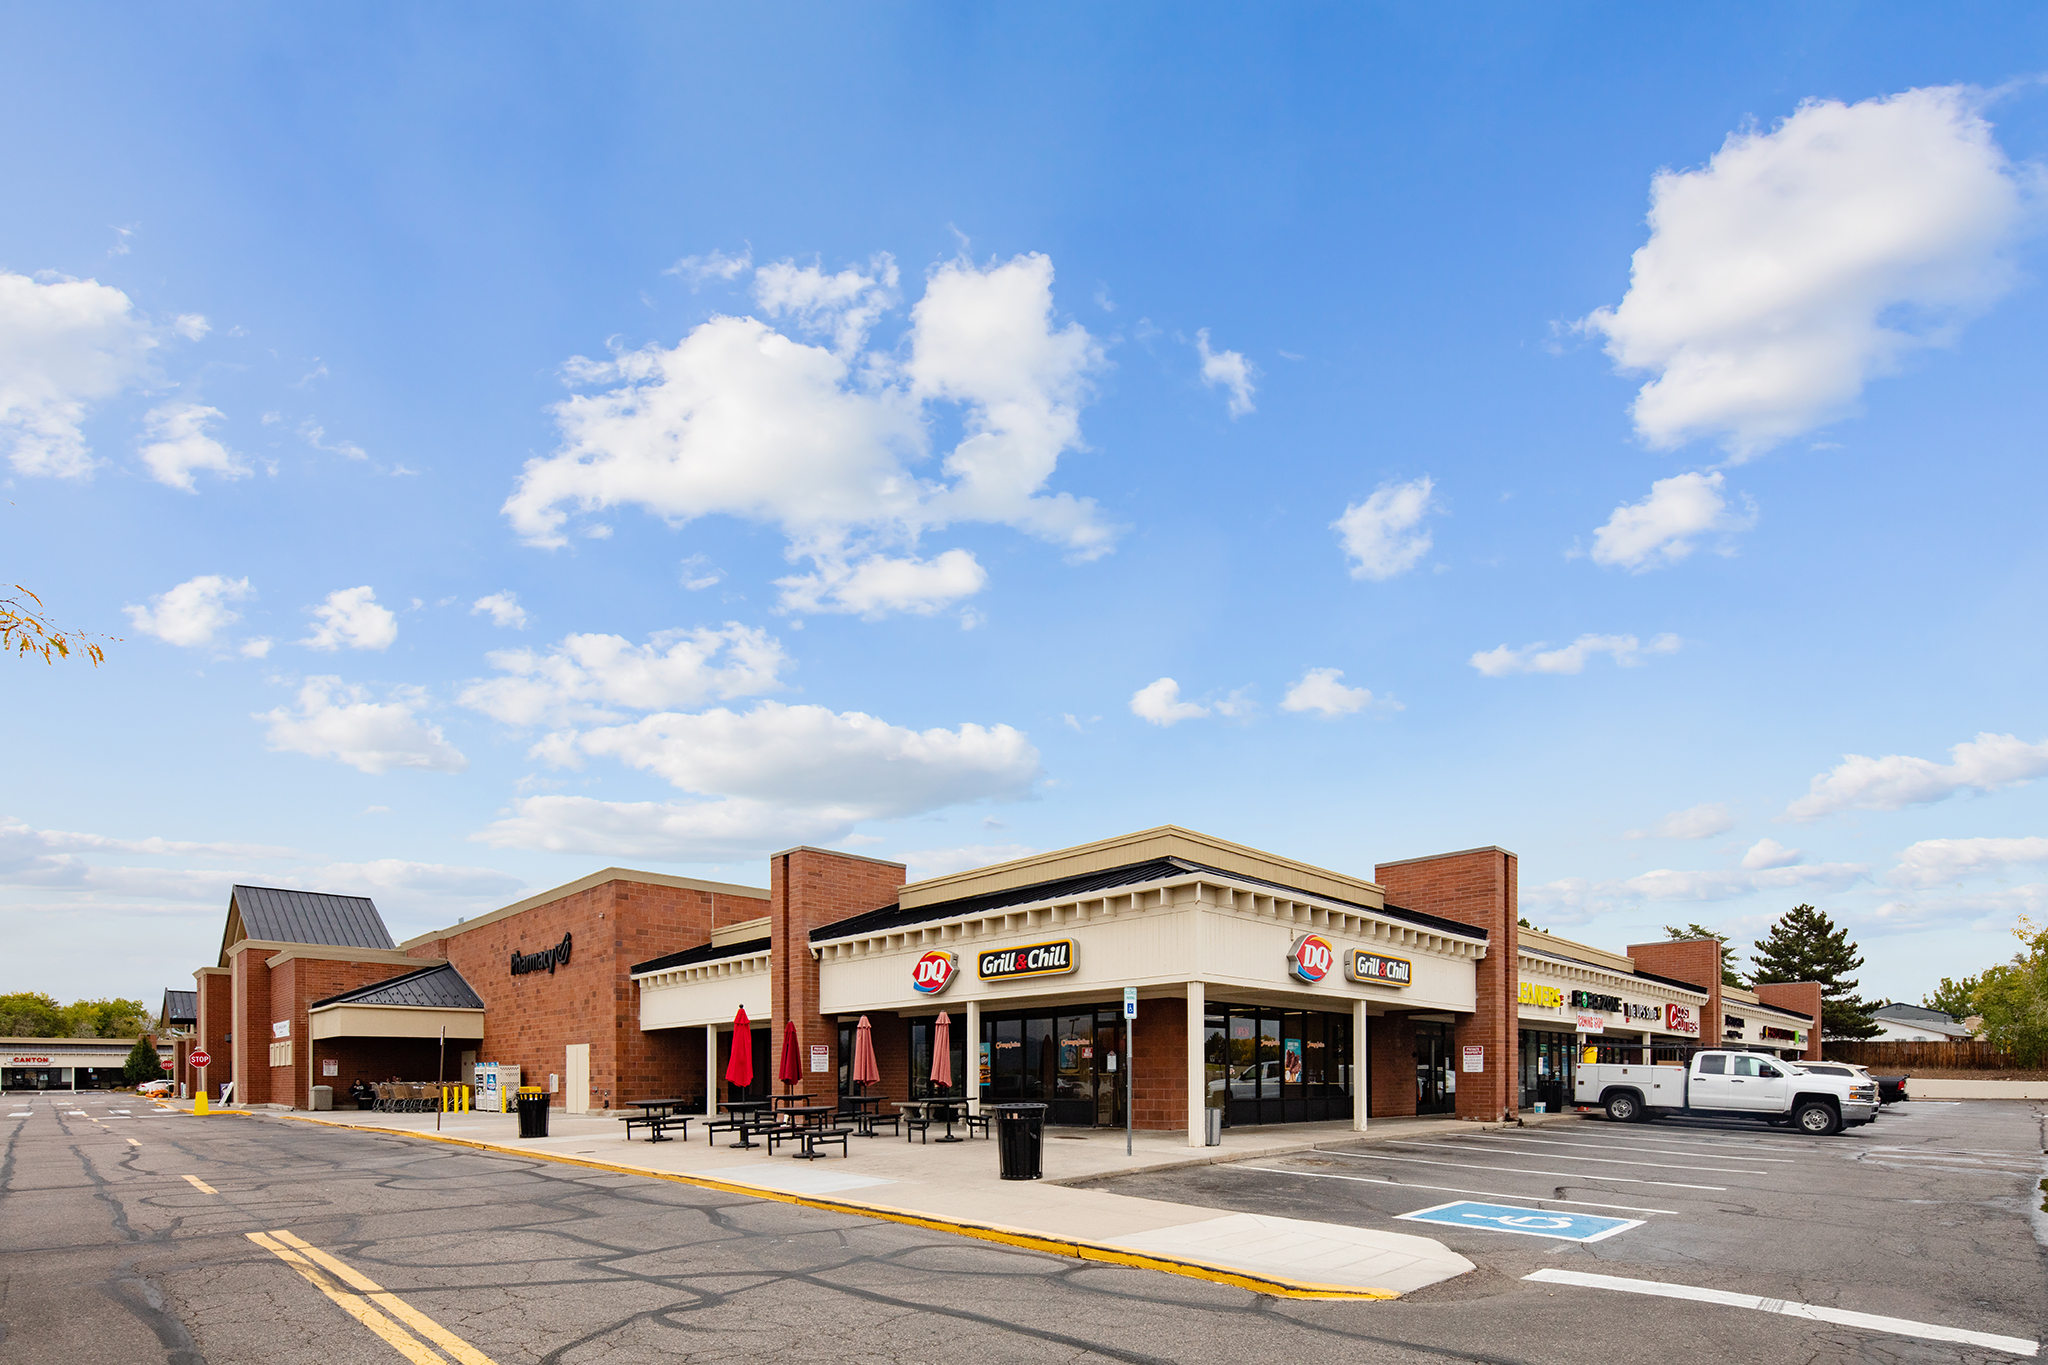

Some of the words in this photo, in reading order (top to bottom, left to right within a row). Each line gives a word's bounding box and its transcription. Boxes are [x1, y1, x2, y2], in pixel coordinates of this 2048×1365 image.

[511, 949, 555, 975] Pharmacy
[918, 959, 946, 983] DQ
[1303, 944, 1327, 973] DQ
[1637, 1004, 1646, 1018] UPS
